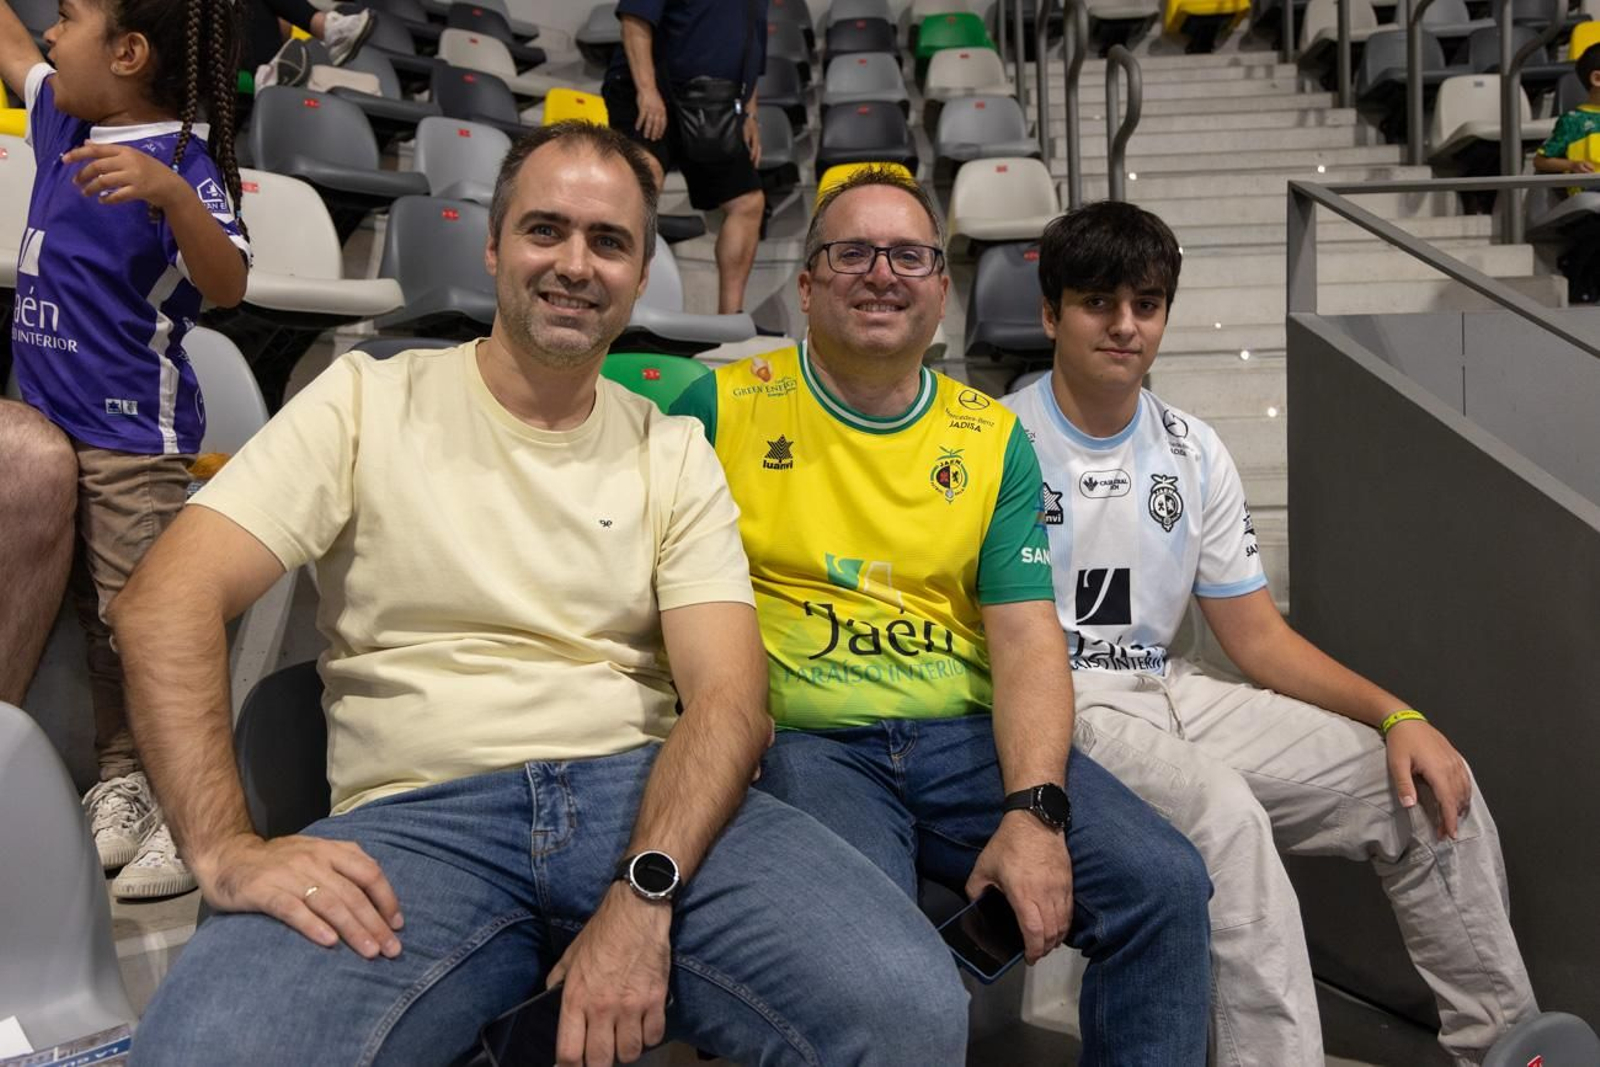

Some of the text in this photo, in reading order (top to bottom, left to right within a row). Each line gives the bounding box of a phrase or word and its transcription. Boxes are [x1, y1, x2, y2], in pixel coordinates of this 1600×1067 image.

[17, 328, 79, 353] INTERIOR
[949, 420, 982, 433] JADISA
[762, 459, 793, 470] luanvi
[803, 600, 954, 661] Jaén
